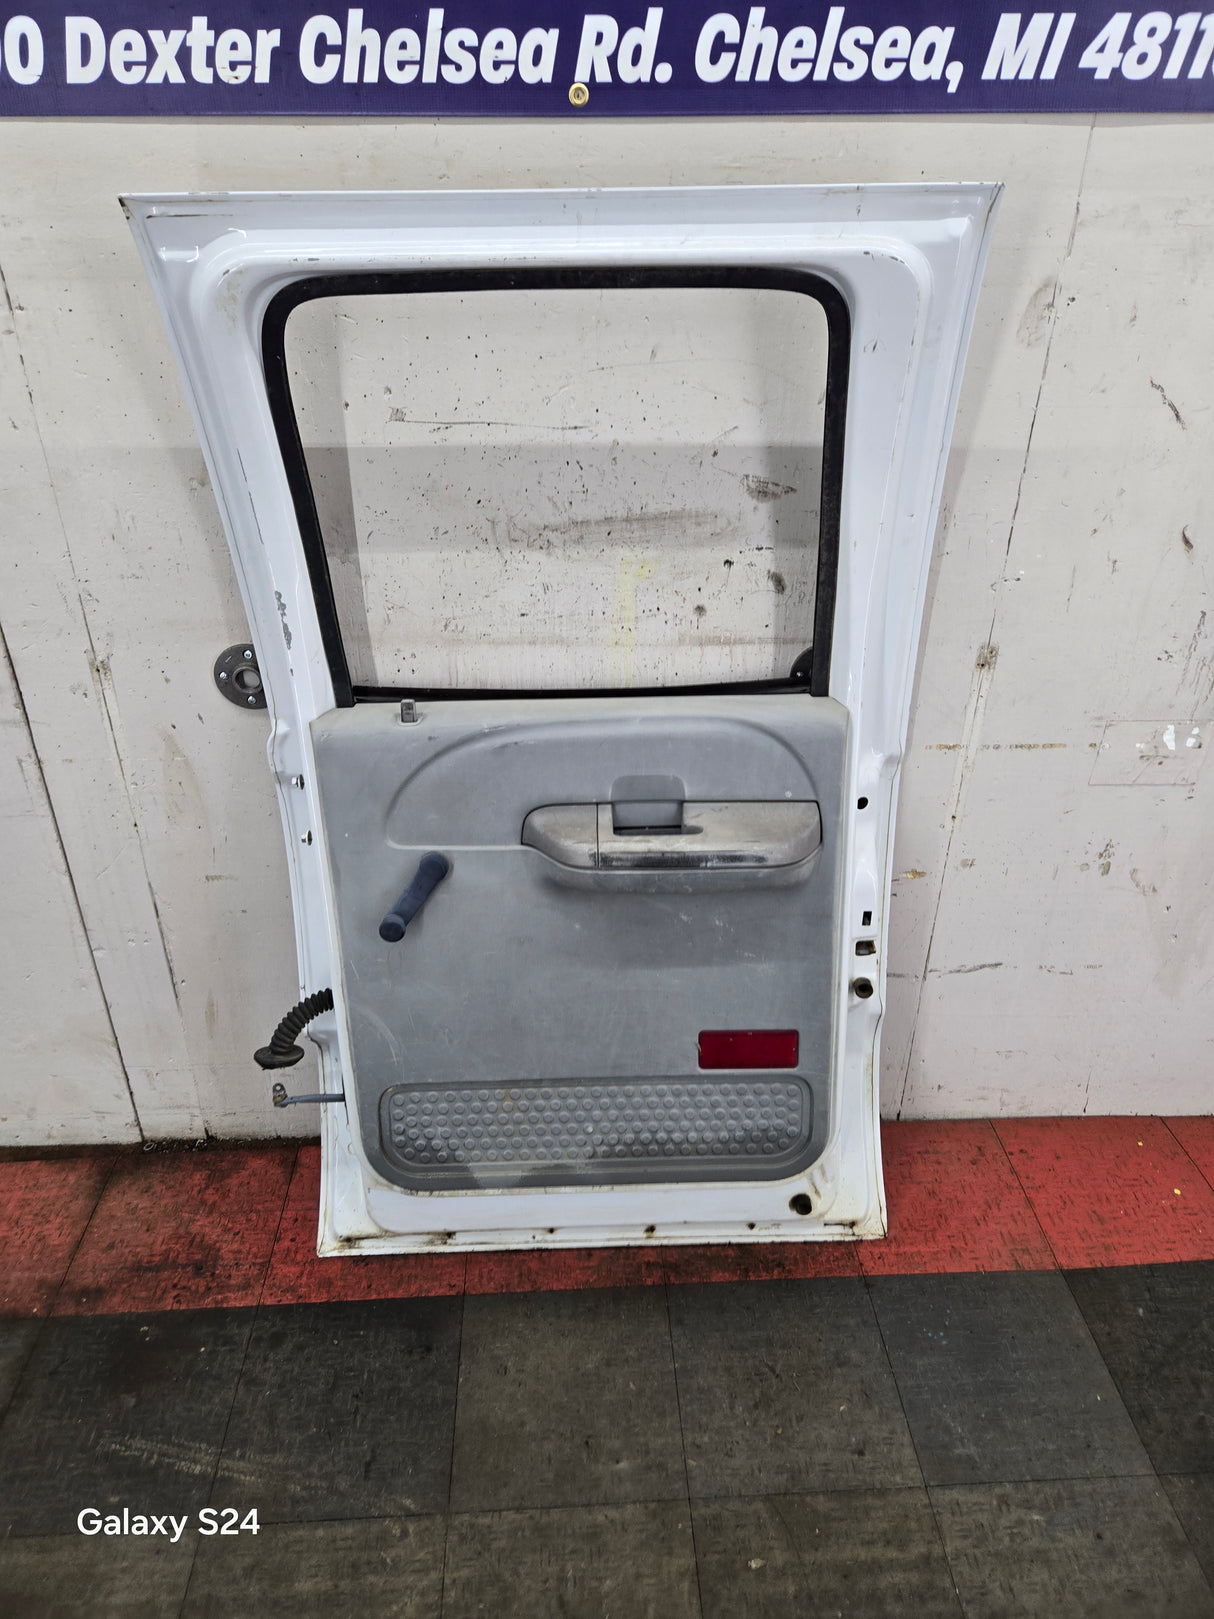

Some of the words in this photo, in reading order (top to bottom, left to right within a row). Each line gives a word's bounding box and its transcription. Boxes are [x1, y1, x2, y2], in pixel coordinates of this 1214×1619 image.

[0, 15, 43, 85] 0
[65, 16, 281, 85] Dexter
[300, 8, 560, 84] Chelsea
[574, 7, 673, 83] Rd.
[695, 6, 964, 93] Chelsea,
[981, 12, 1077, 80] MI
[1078, 11, 1214, 80] 4811
